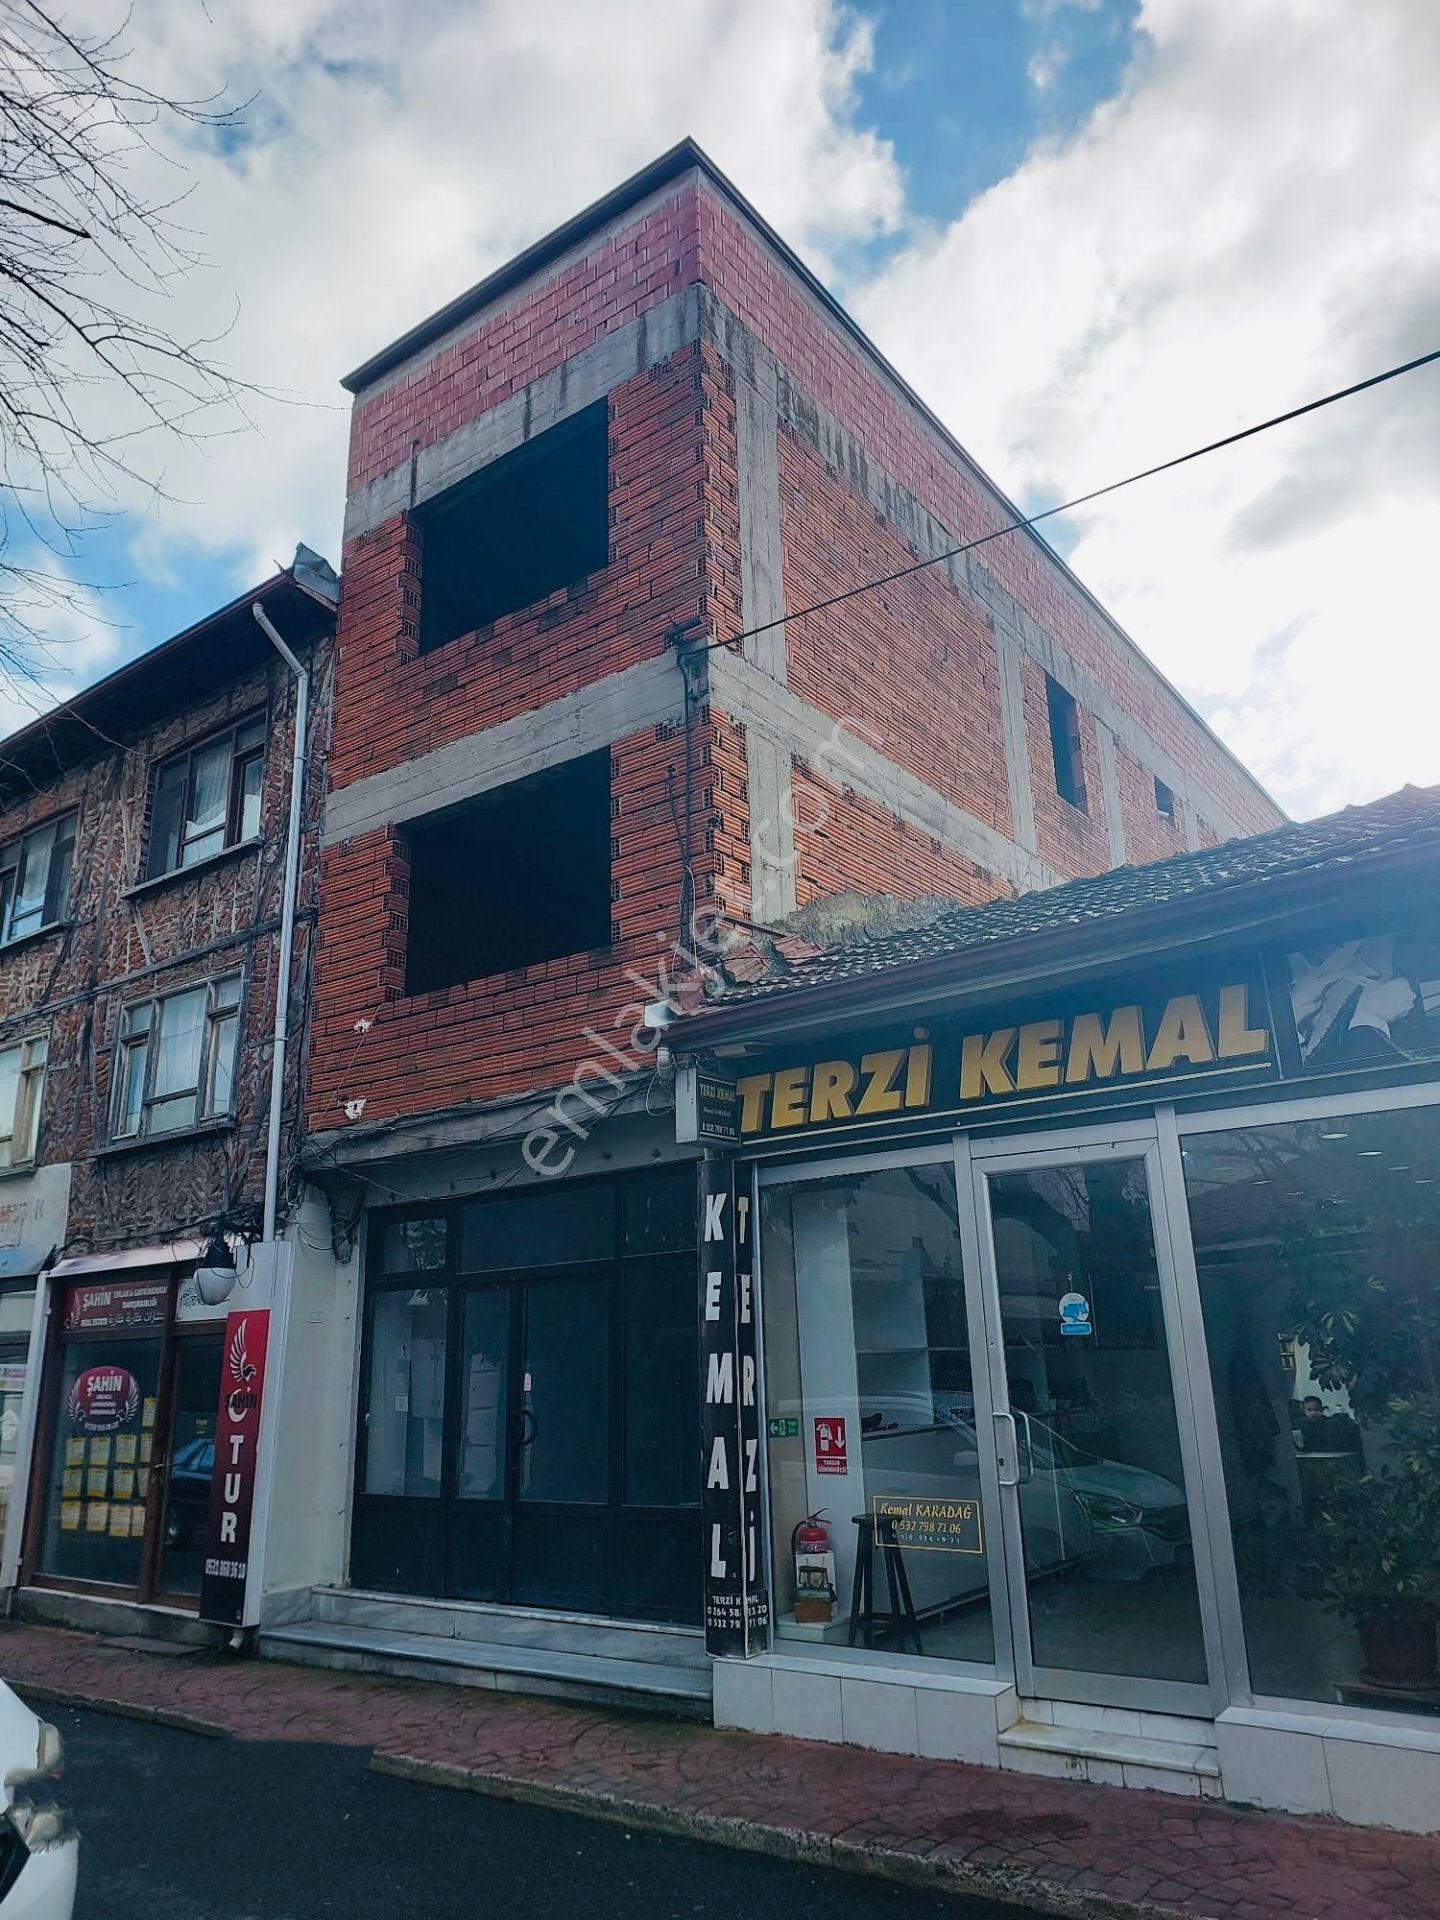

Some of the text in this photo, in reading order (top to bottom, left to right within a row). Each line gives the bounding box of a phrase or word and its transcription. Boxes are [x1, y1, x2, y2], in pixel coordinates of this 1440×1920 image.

[738, 984, 1270, 1135] TERZİ KEMAL
[82, 1287, 112, 1312] ŞAHİN
[87, 1370, 122, 1397] ŞAHİN
[704, 1193, 733, 1578] KEMAL
[738, 1196, 758, 1582] TERZİ
[219, 1435, 244, 1544] TUR
[880, 1501, 972, 1519] Kemal KARADAĞ
[891, 1520, 961, 1534] 0 532 798 71 06
[707, 1606, 712, 1615] 0
[713, 1606, 726, 1617] 264
[712, 1595, 733, 1606] TERZİ
[757, 1616, 767, 1626] 06
